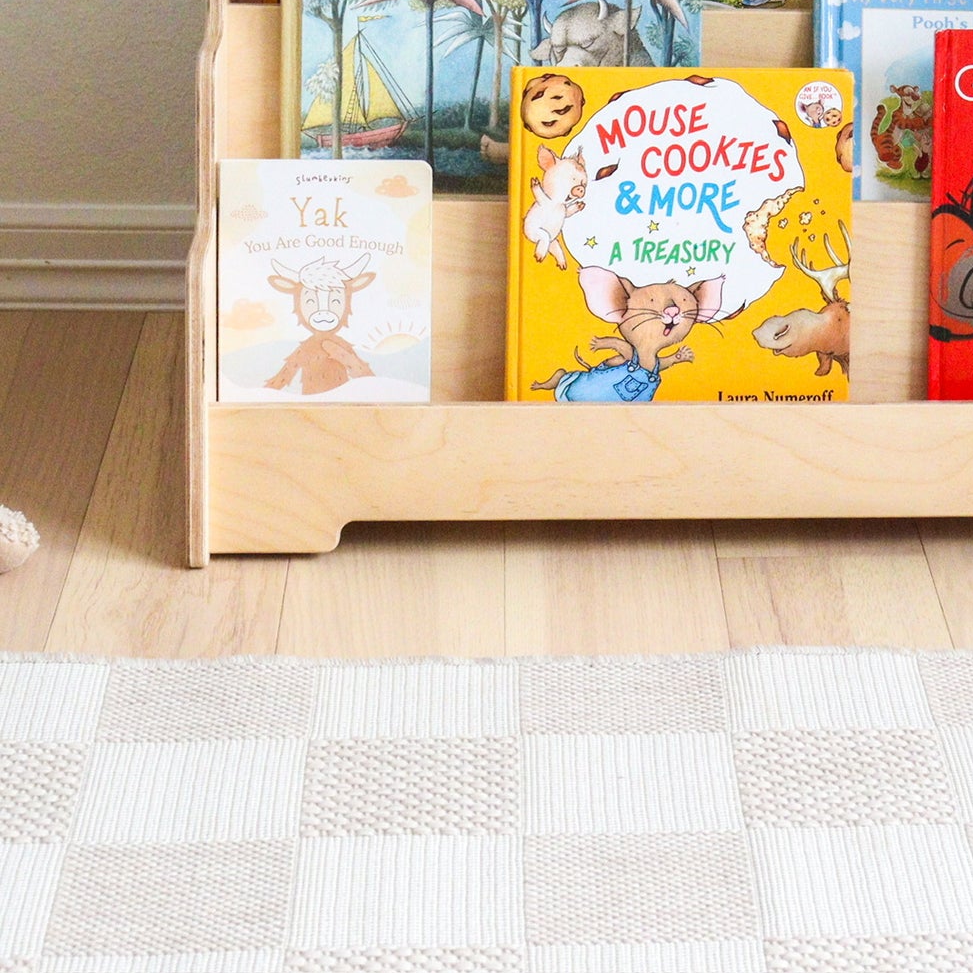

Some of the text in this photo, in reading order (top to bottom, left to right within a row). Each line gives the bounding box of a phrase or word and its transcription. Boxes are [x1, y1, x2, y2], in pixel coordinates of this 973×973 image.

[912, 15, 968, 30] Pooh's
[596, 103, 709, 155] MOUSE
[640, 135, 789, 182] COOKIES
[289, 196, 348, 228] Yak
[614, 179, 740, 233] & MORE
[244, 234, 404, 255] You Are Good Enough
[608, 237, 736, 266] A TREASURY
[718, 390, 834, 402] Laura Numeroff
